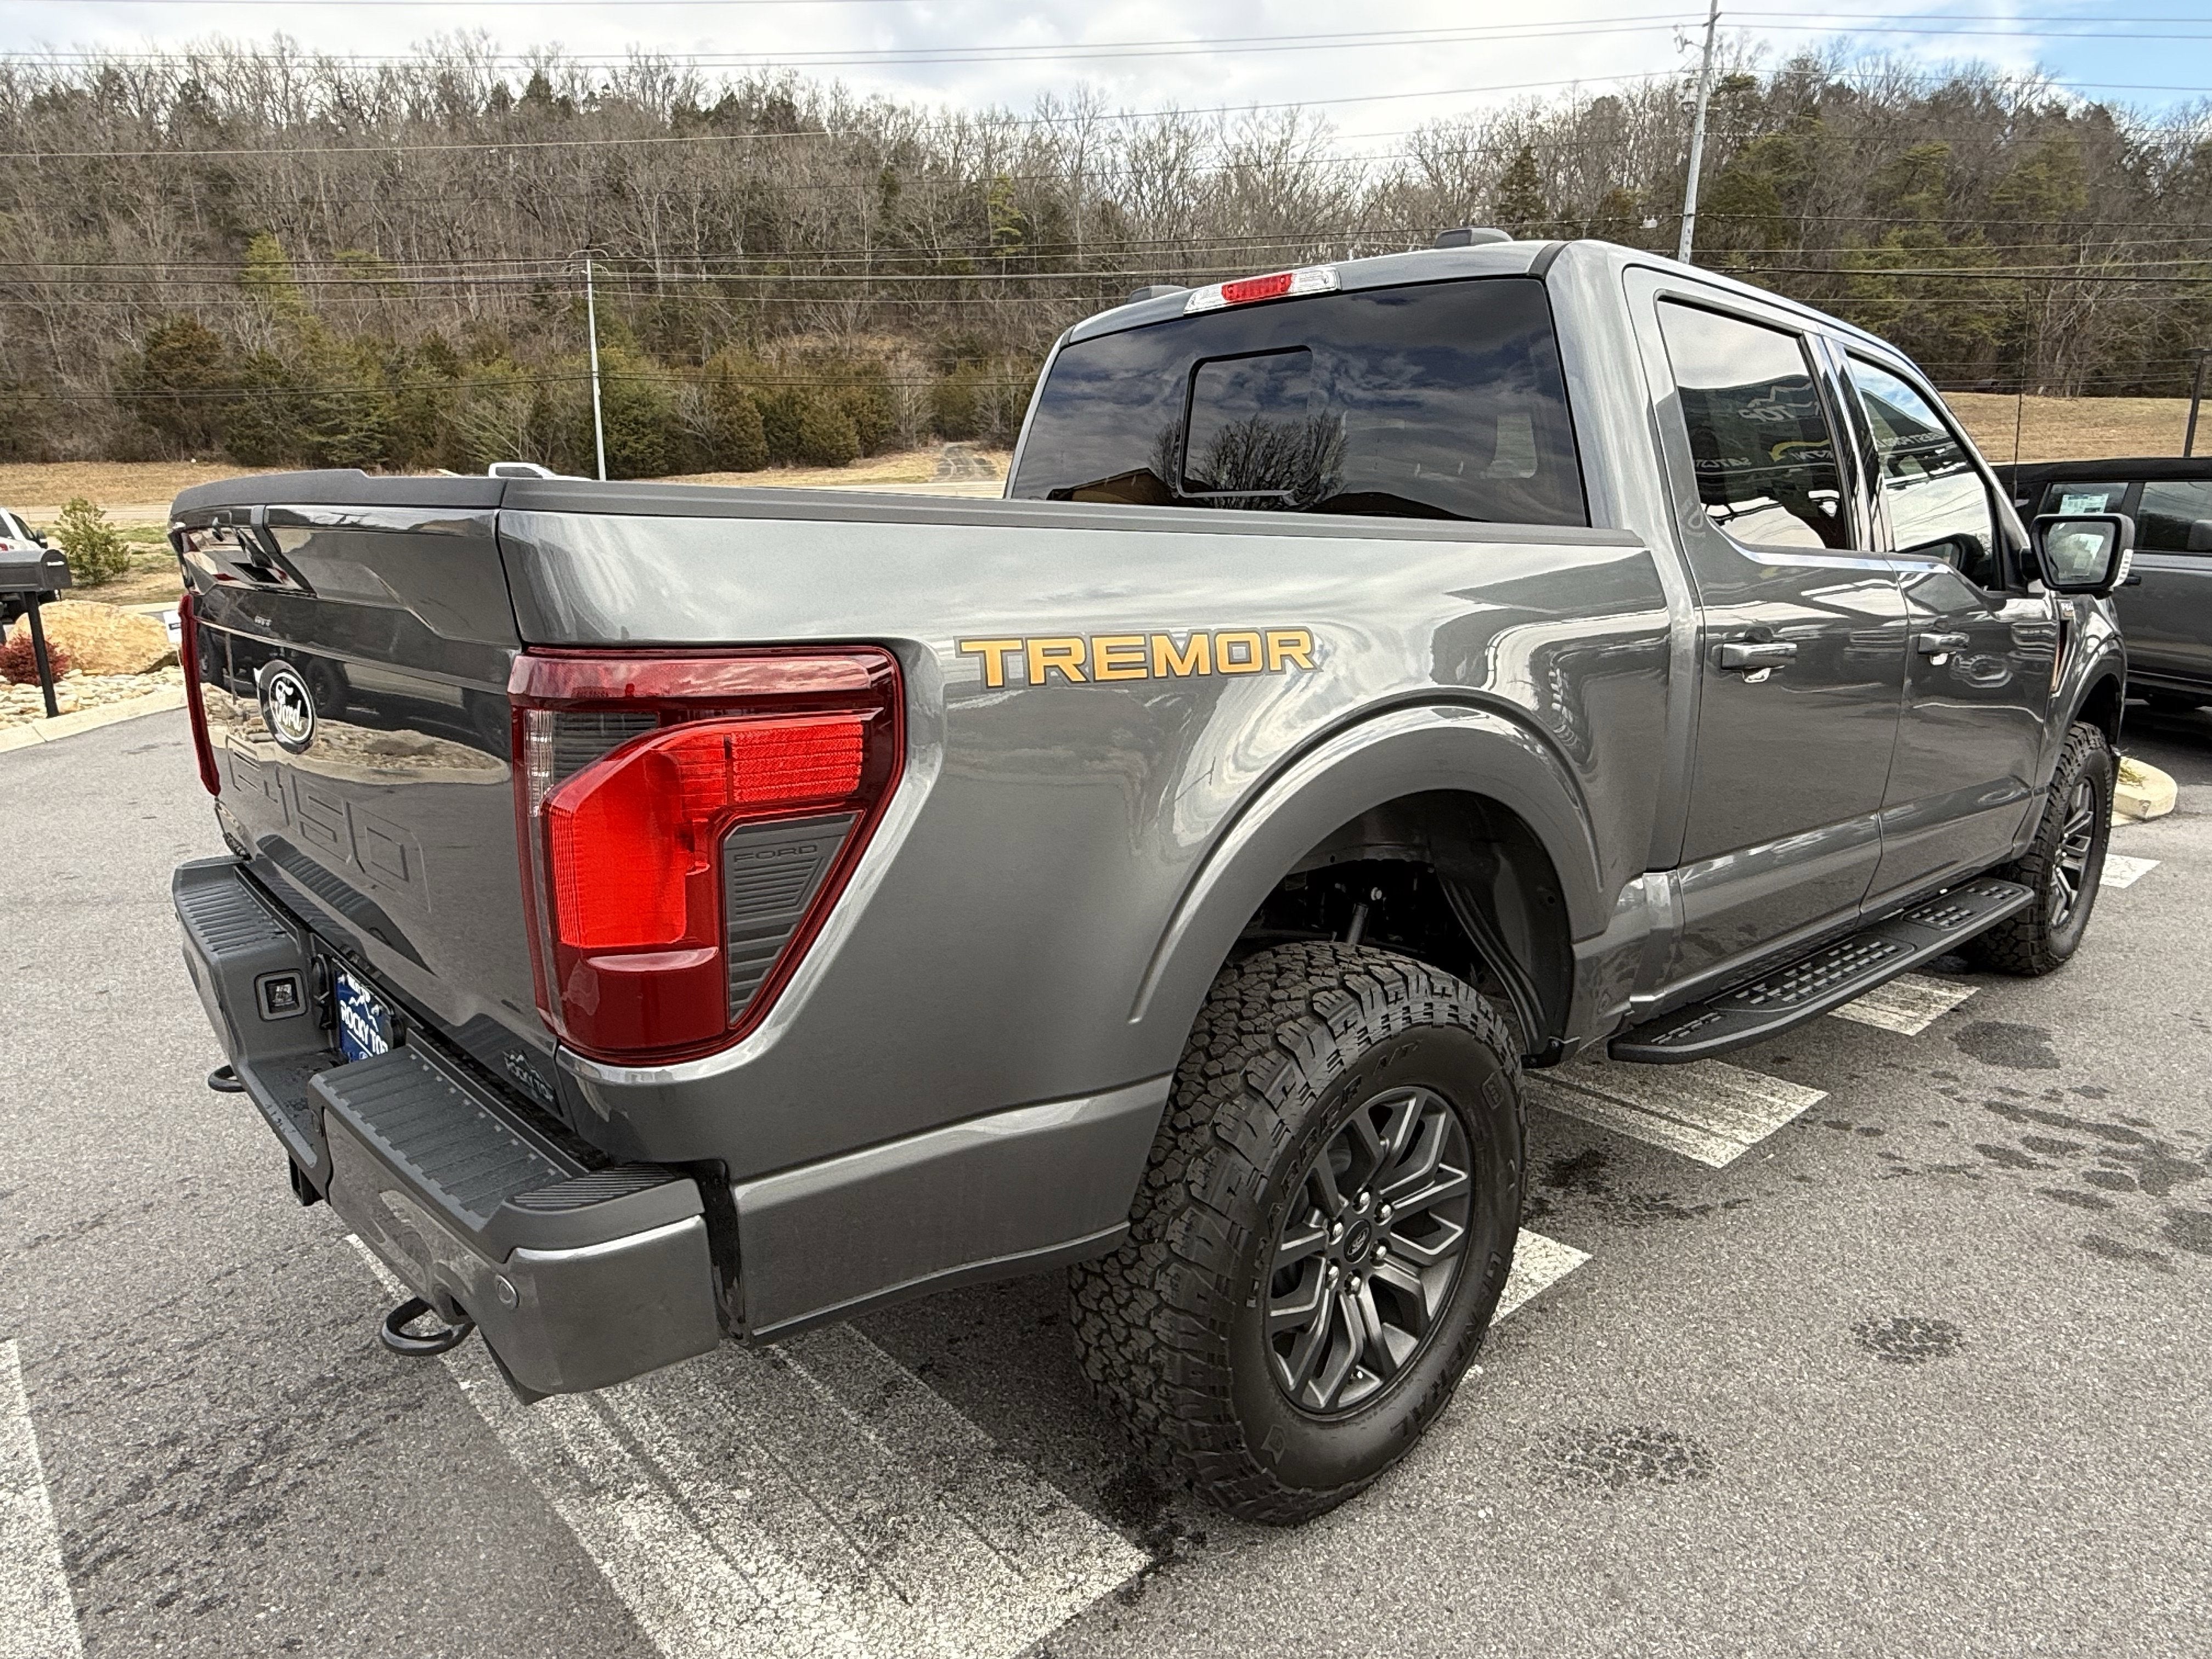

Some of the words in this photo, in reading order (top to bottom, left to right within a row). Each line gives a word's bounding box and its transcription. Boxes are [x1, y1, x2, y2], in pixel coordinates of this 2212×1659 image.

[956, 627, 1321, 690] TREMOR
[275, 680, 303, 732] Ford
[733, 844, 818, 863] FORD
[340, 1000, 369, 1046] ROCKY
